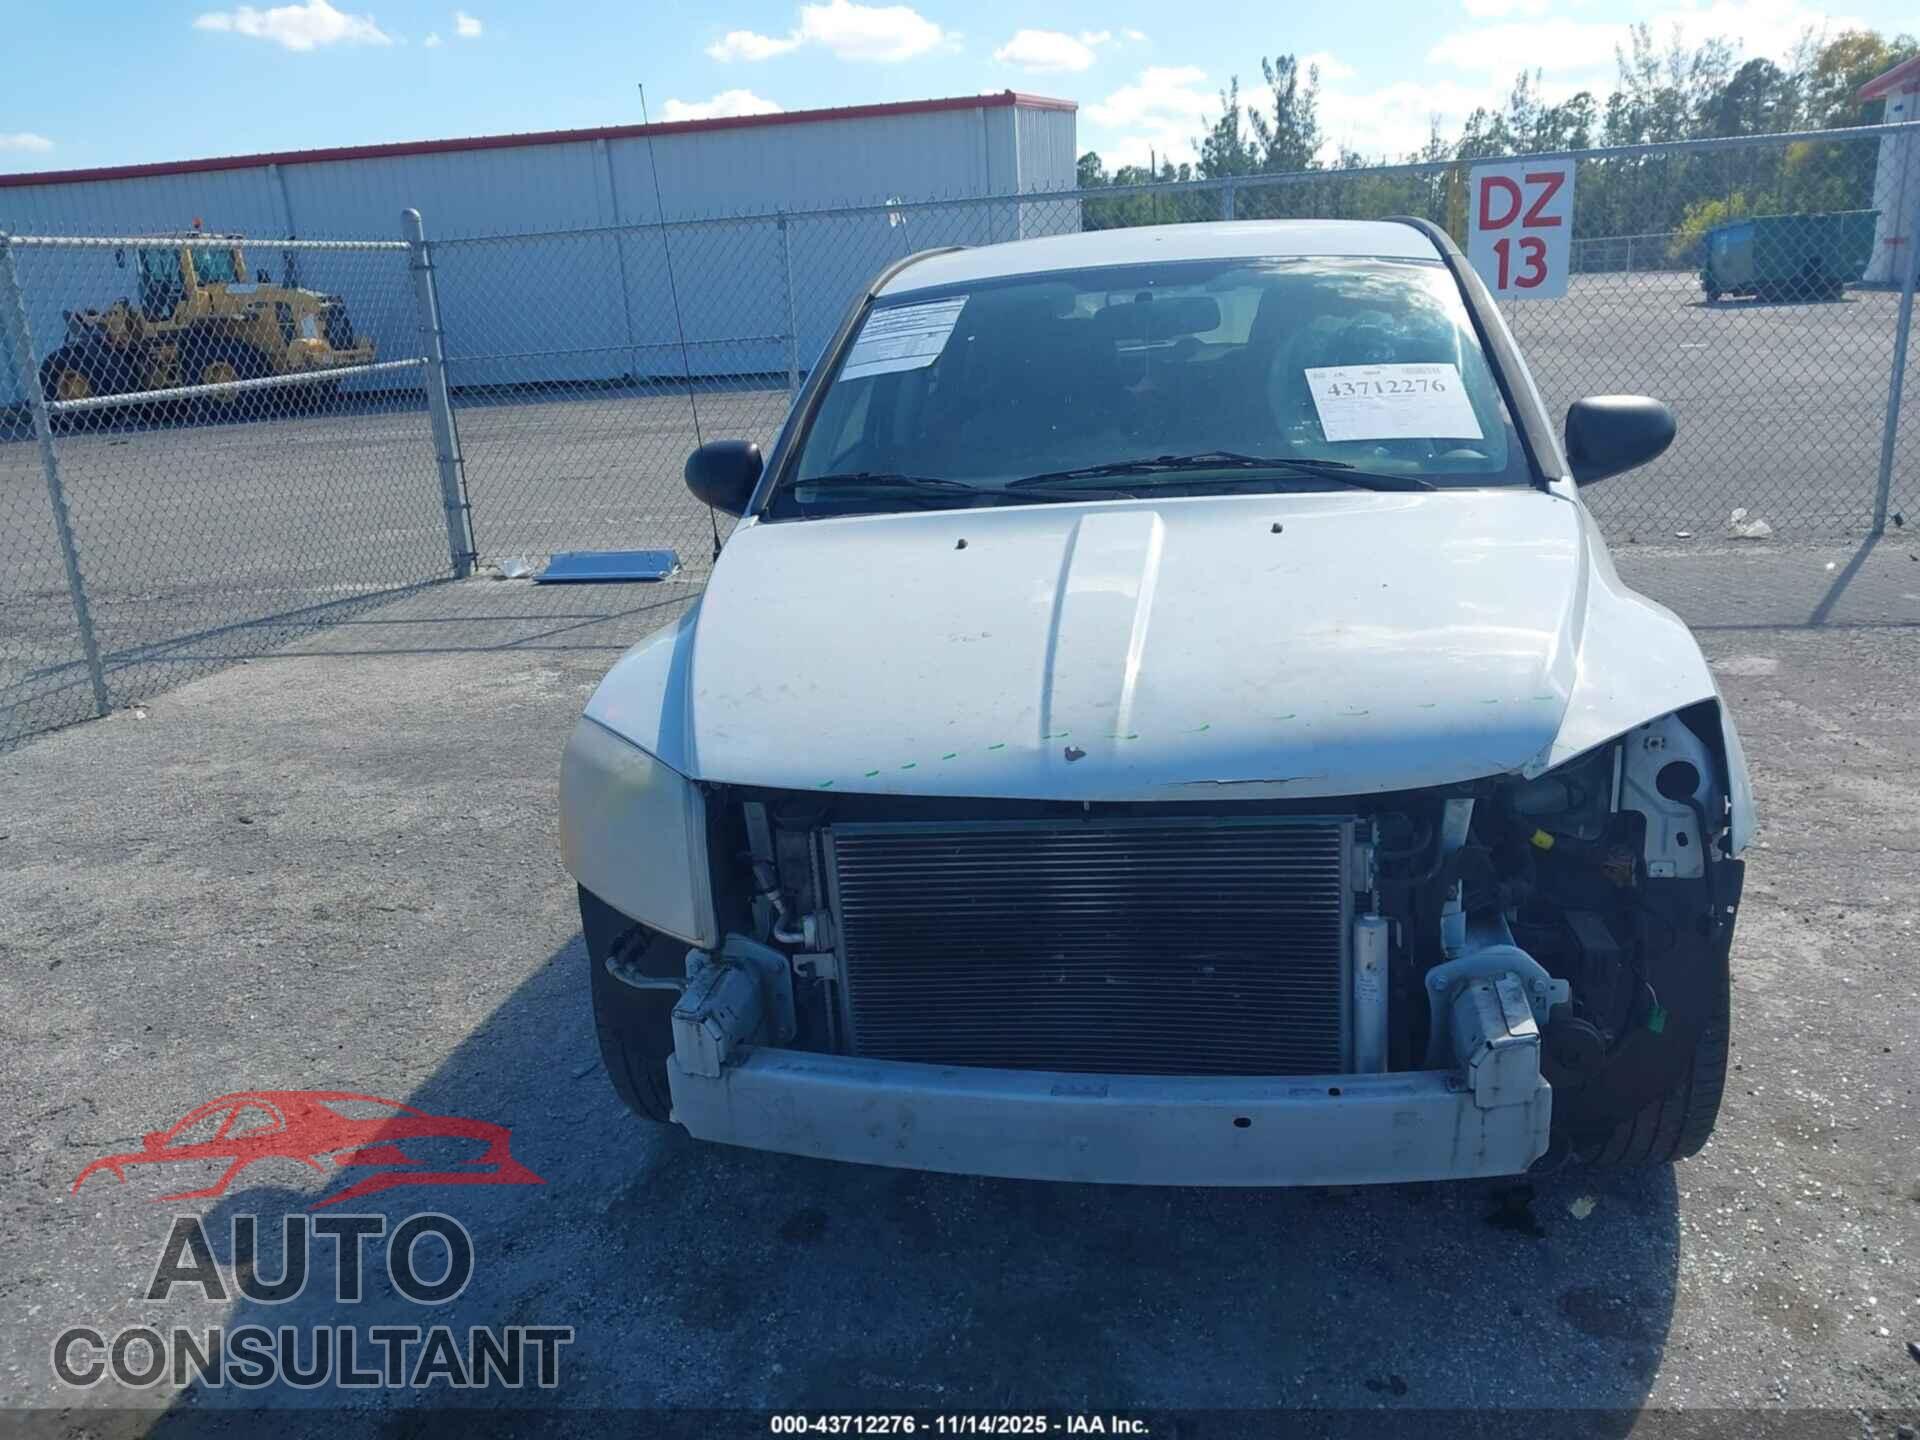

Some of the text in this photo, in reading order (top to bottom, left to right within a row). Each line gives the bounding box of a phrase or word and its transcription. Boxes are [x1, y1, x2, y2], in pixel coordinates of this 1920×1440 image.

[1479, 171, 1566, 231] DZ
[1493, 236, 1548, 290] 13
[1327, 378, 1446, 396] 43712276
